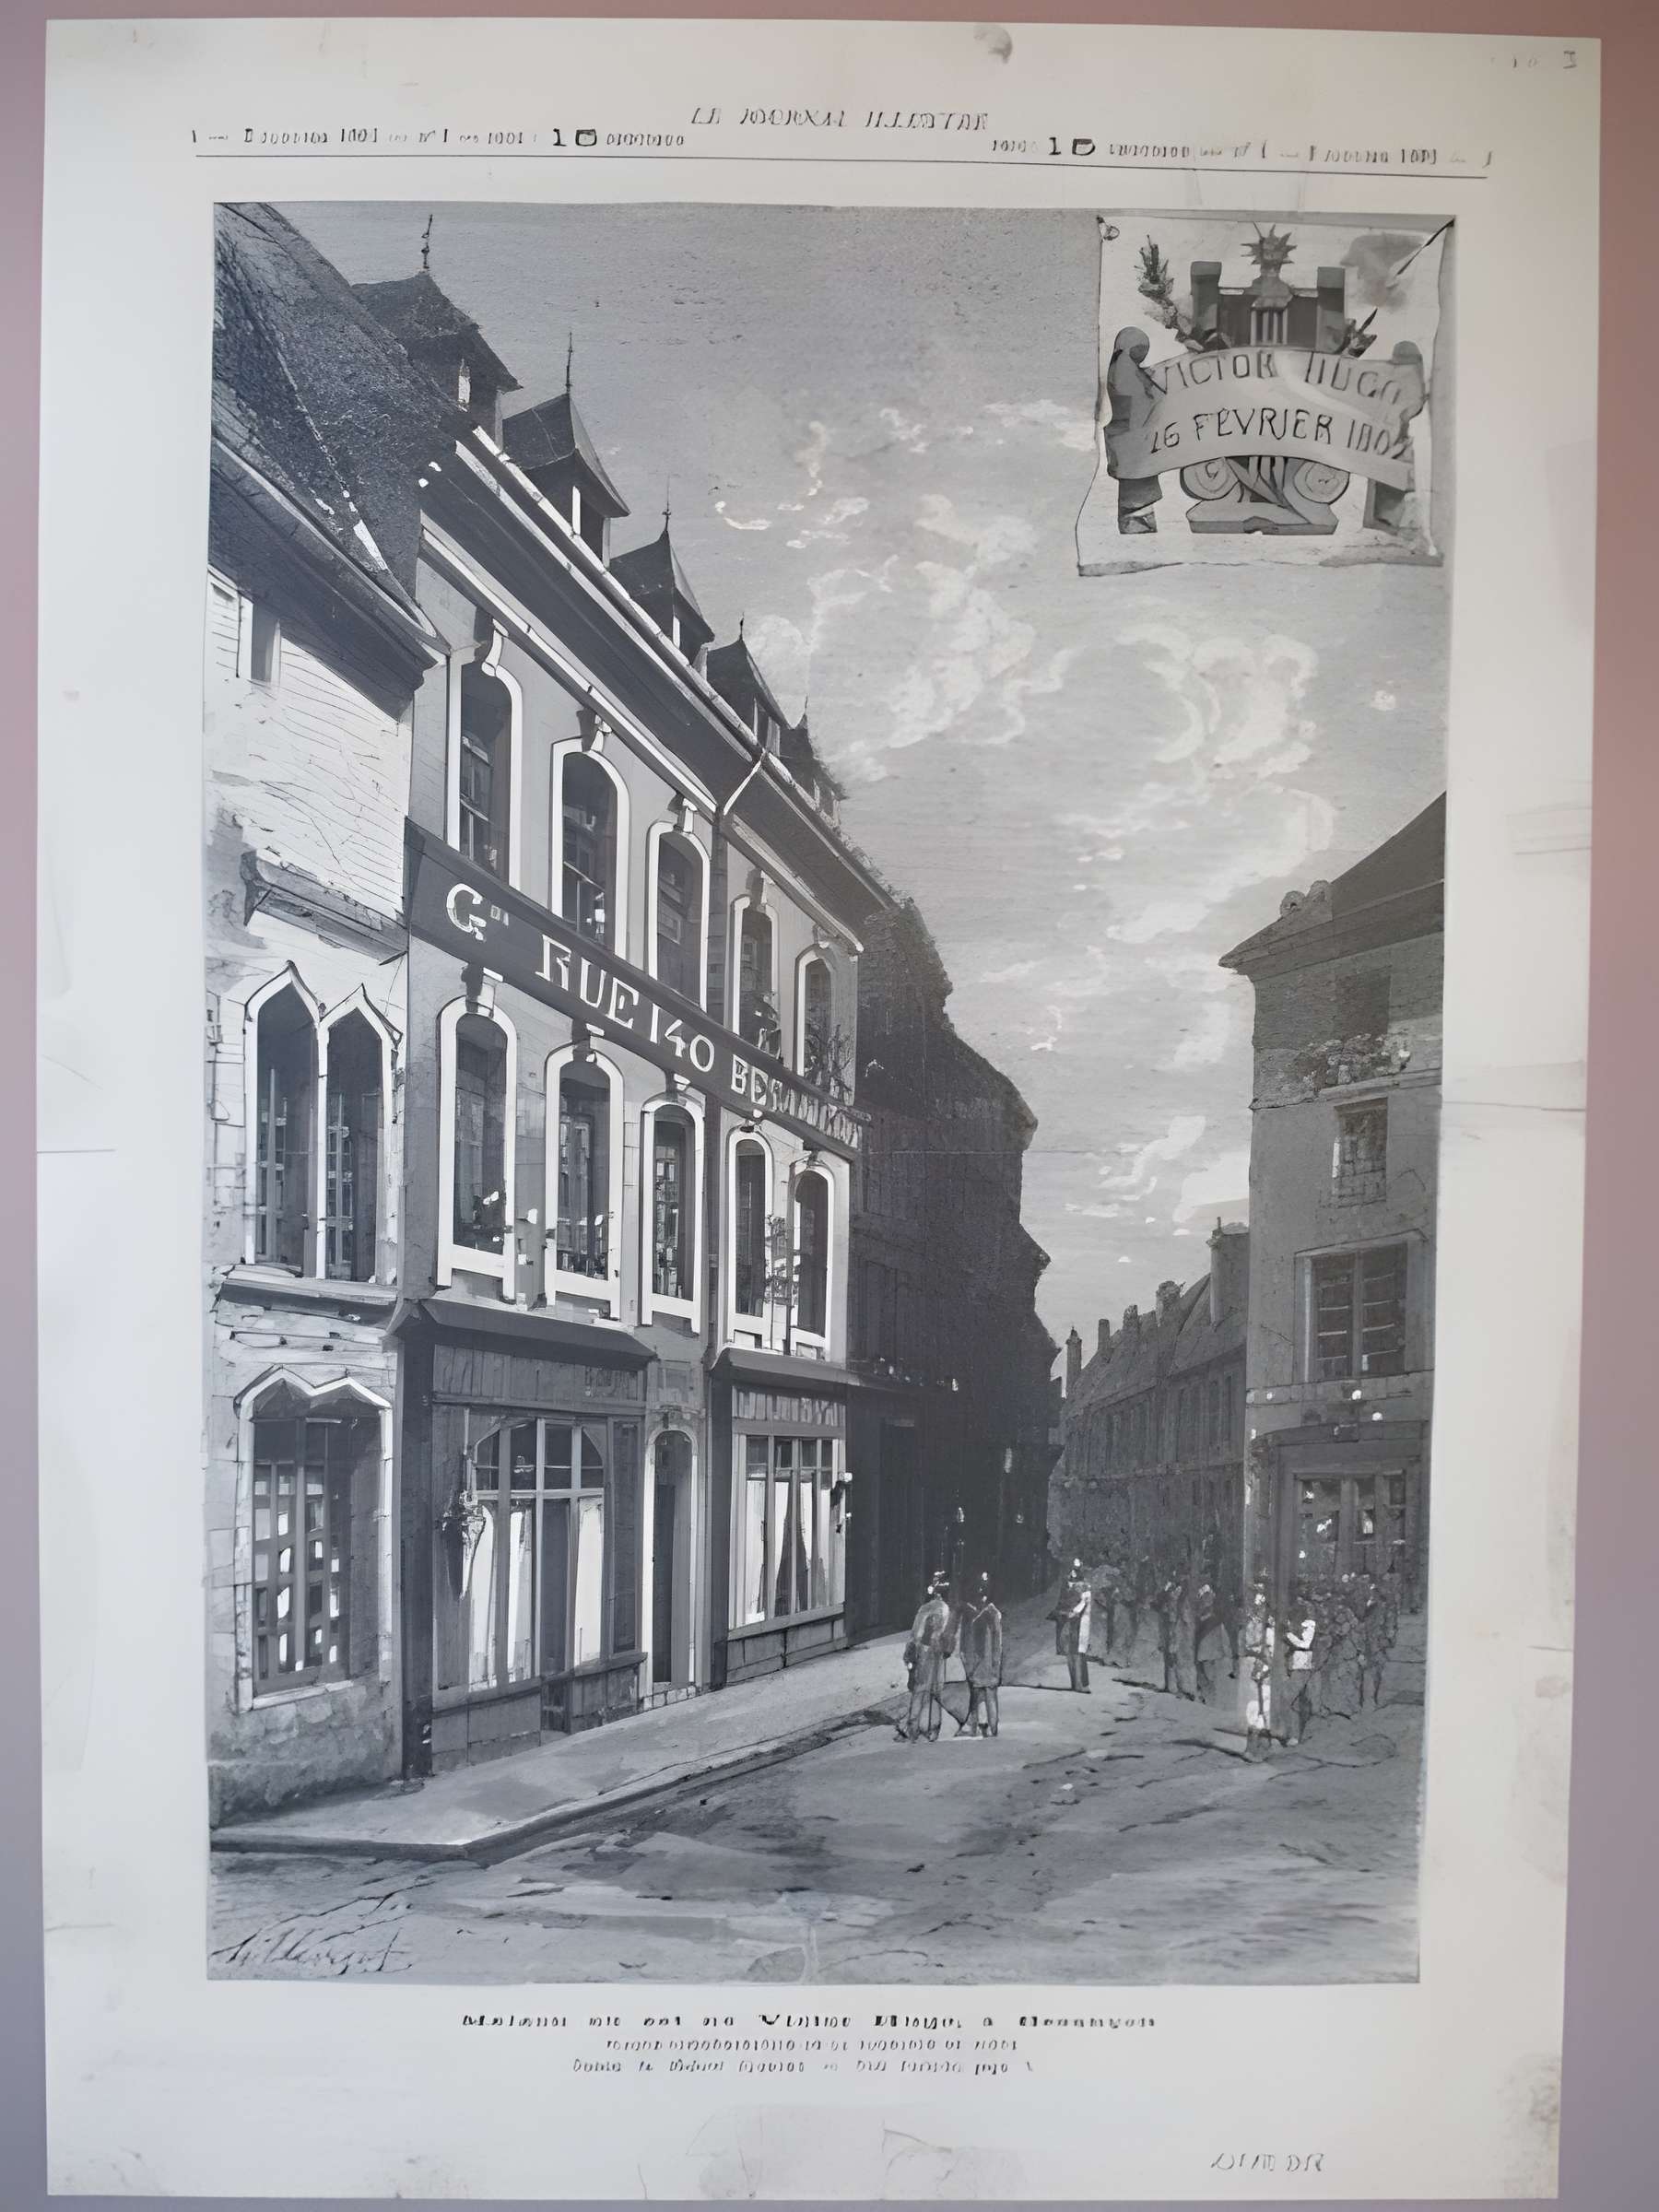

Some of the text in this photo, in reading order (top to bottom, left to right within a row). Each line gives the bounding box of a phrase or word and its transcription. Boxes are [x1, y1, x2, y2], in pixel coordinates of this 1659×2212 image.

[1149, 349, 1277, 395] VICTOR
[535, 934, 640, 1030] RUE
[649, 1002, 715, 1073] 140
